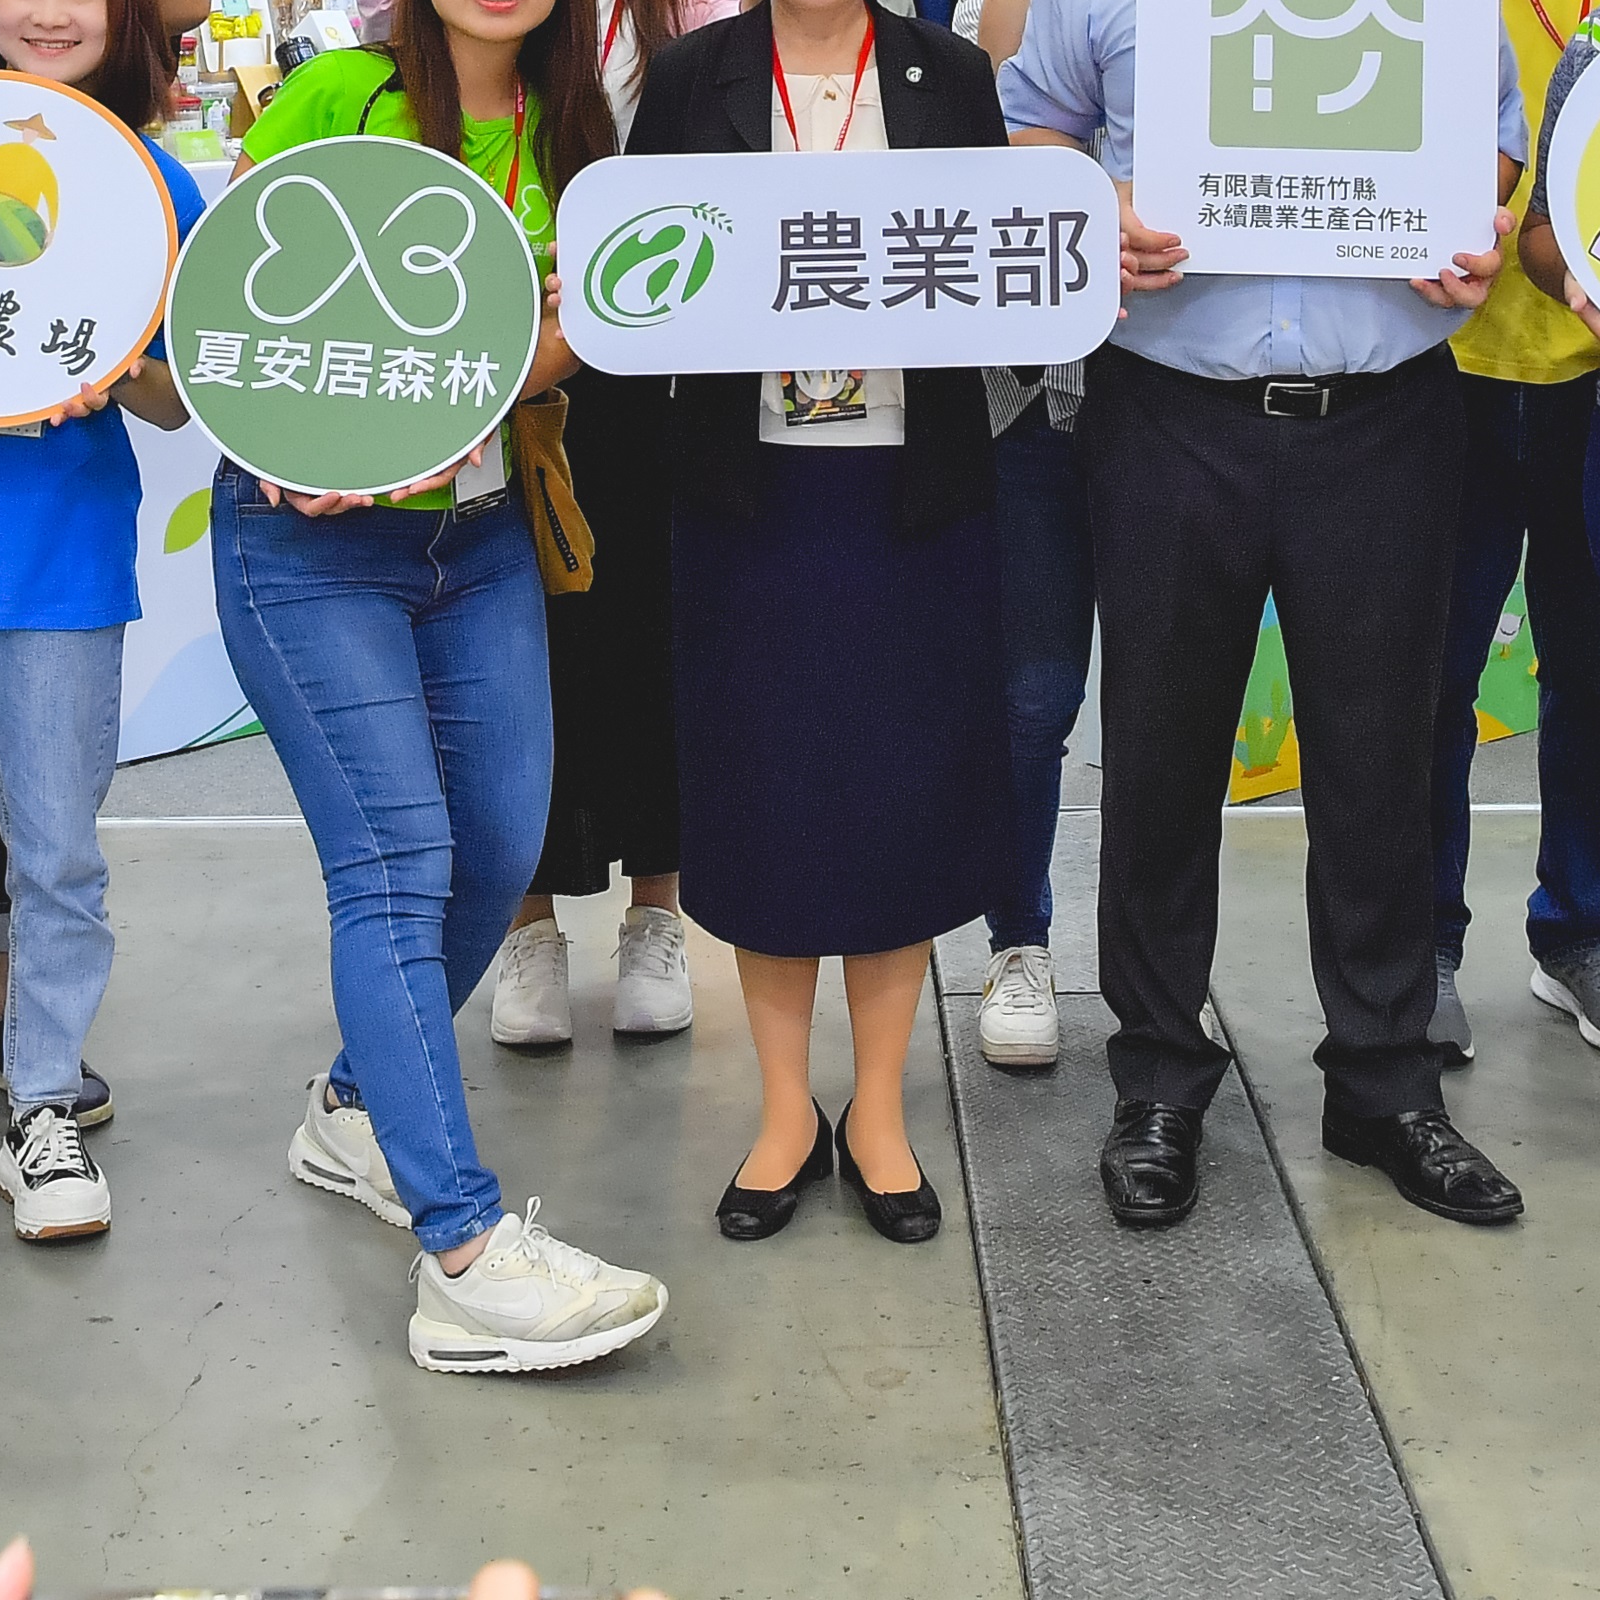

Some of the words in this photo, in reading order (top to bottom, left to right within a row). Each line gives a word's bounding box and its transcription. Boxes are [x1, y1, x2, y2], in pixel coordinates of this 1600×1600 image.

[1198, 174, 1378, 201] 有限責任新竹縣
[1197, 203, 1428, 233] 永續農業生產合作社
[771, 207, 1091, 313] 農業部
[1336, 244, 1385, 259] SICNE
[1390, 245, 1429, 260] 2024
[187, 329, 501, 408] 夏安居森林
